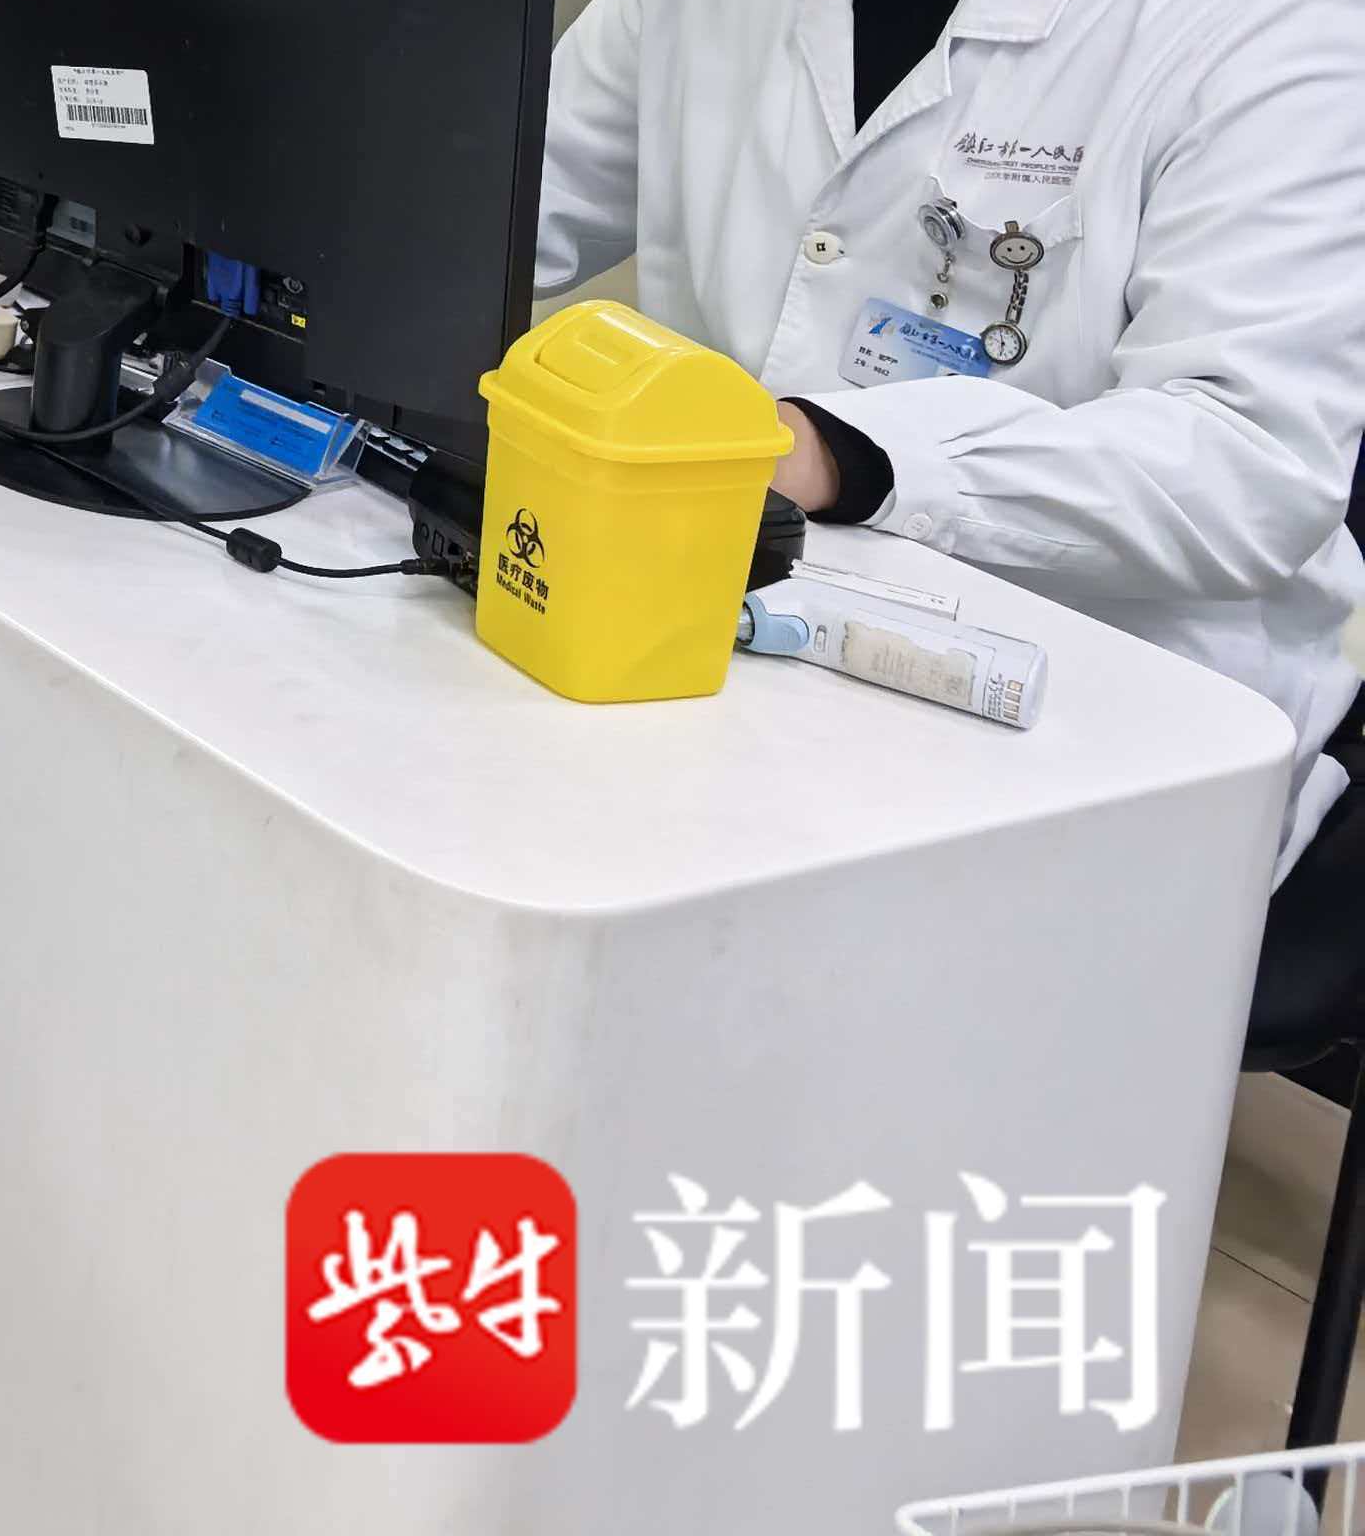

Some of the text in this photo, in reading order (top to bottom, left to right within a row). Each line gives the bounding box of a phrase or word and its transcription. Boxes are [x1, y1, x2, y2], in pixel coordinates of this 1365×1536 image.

[496, 571, 546, 615] Medical Waste
[498, 552, 549, 601] 医疗废物
